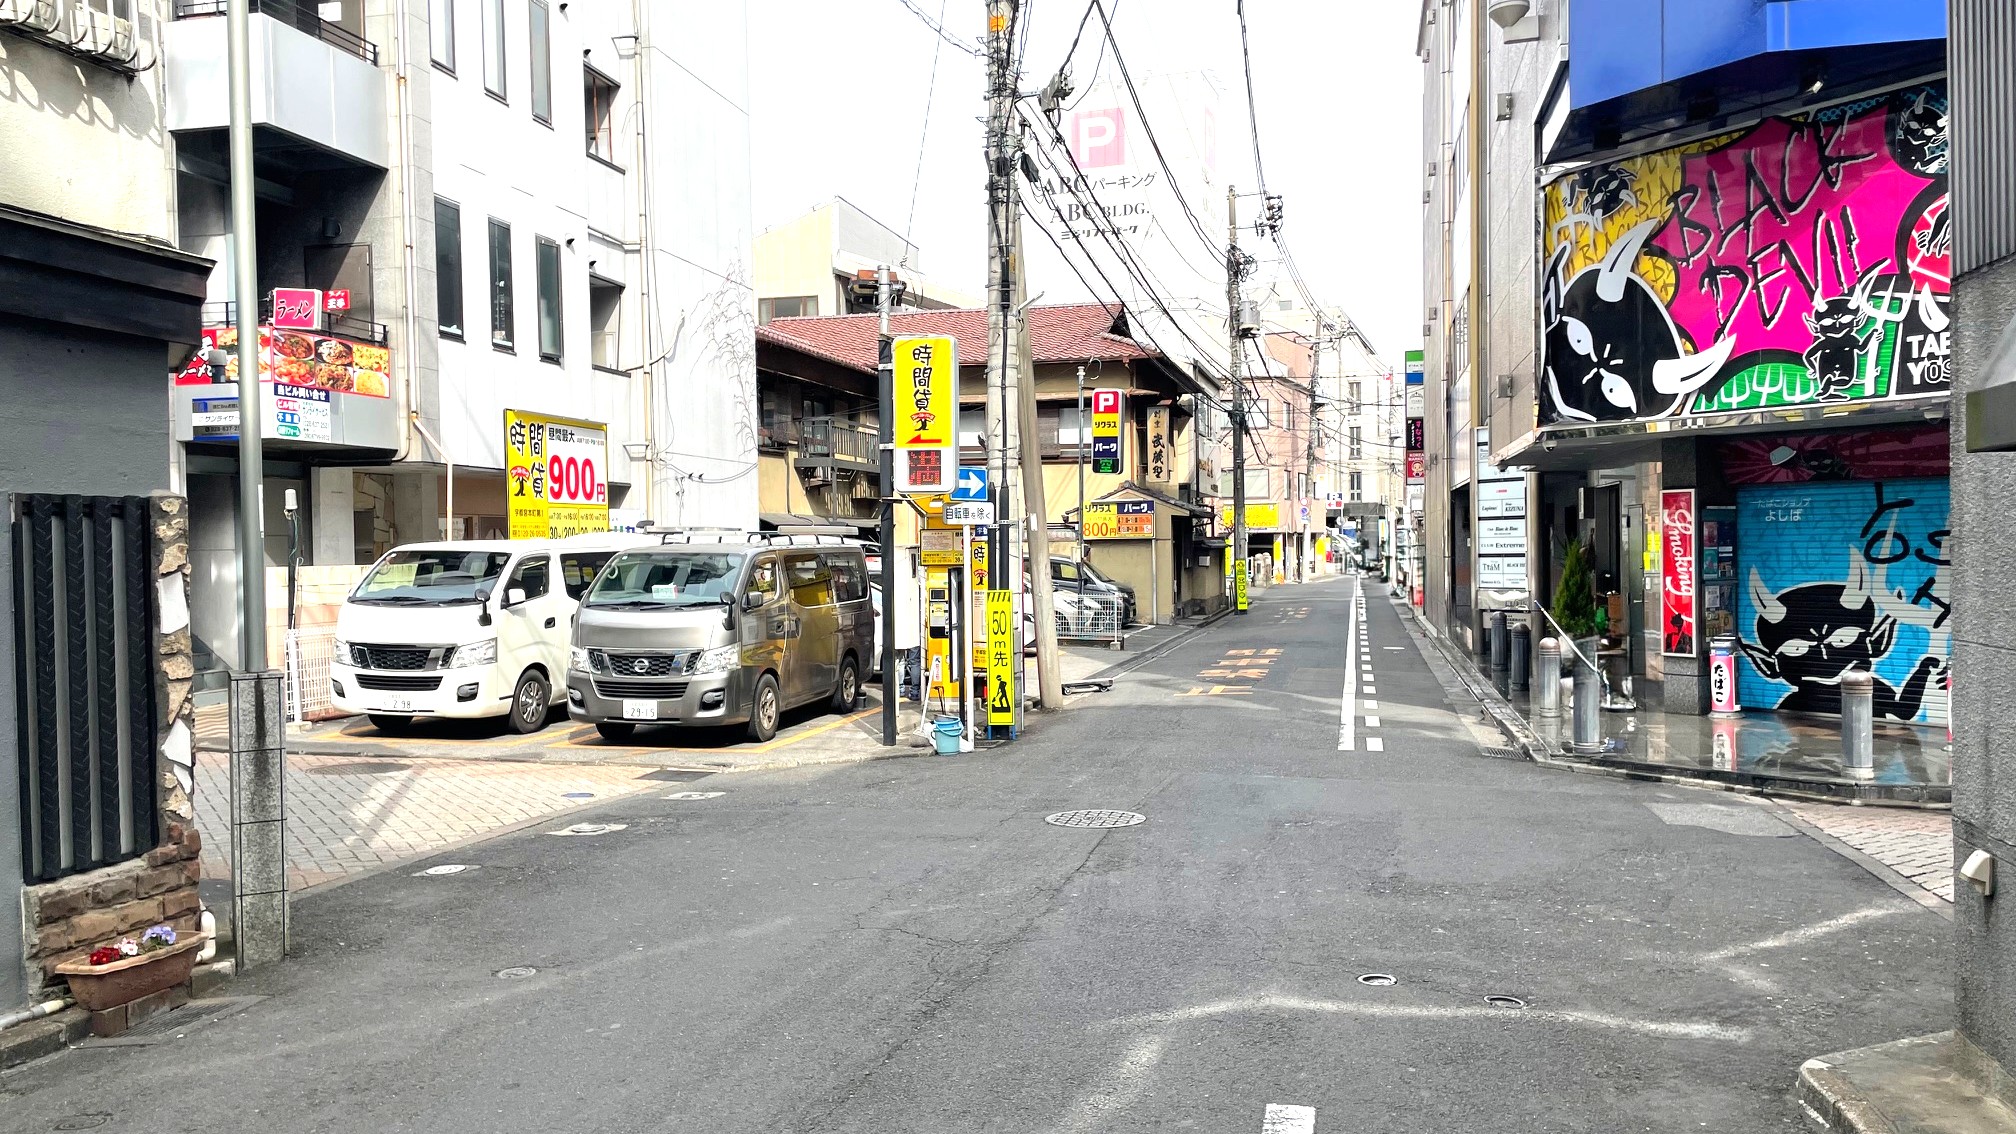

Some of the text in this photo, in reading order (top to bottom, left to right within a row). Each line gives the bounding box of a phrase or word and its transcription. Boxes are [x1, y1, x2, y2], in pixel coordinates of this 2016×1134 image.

[1079, 117, 1116, 163] P
[1667, 110, 1878, 270] BLACK
[277, 300, 314, 319] ラーメン
[912, 344, 933, 412] 時間貸
[1099, 394, 1114, 412] P
[1095, 443, 1117, 452] パーク
[908, 451, 941, 486] 満
[1100, 459, 1112, 472] 空
[946, 507, 990, 520] 自転車を除く
[1085, 505, 1111, 513] リクラス
[1124, 503, 1148, 513] パーク
[1765, 509, 1803, 521] よしば
[1664, 508, 1694, 597] Smoking
[1714, 664, 1726, 703] たばこ
[631, 707, 655, 717] 29-15
